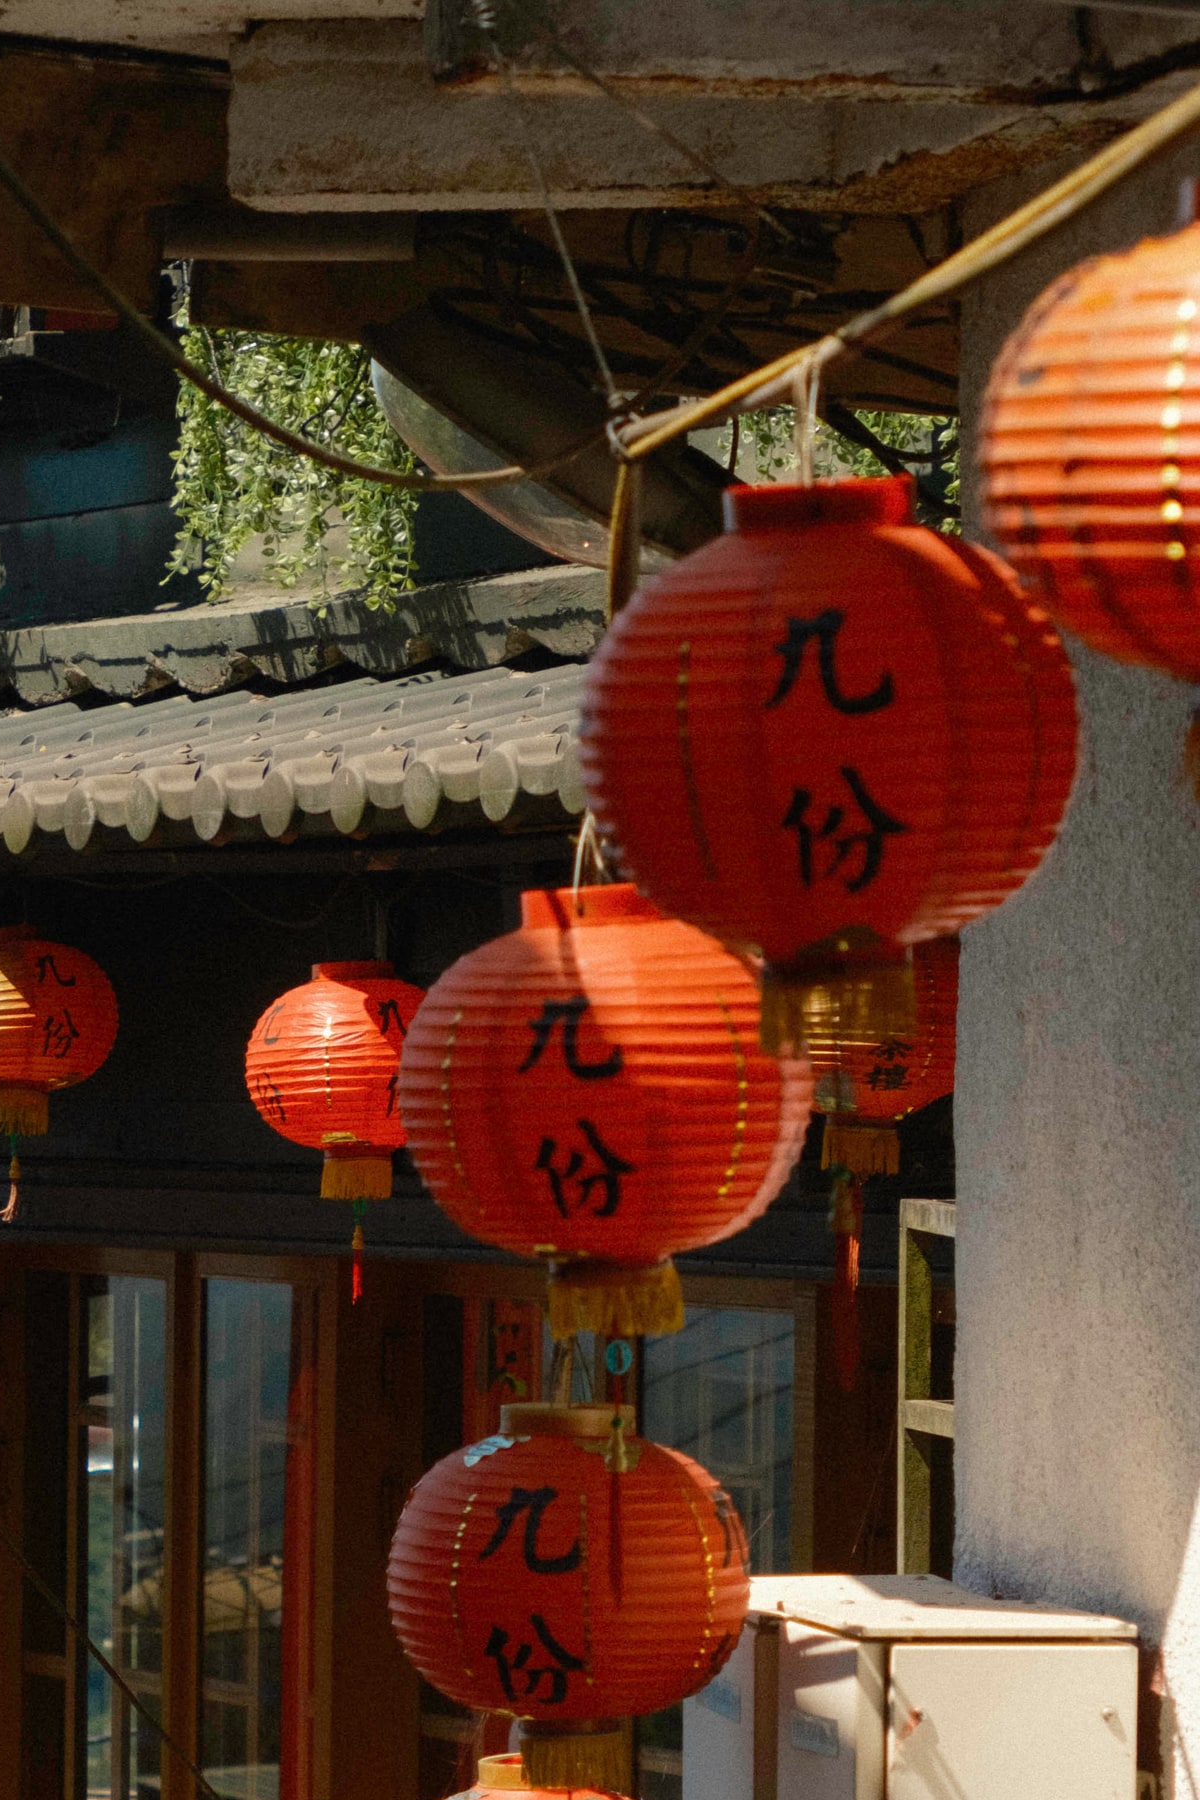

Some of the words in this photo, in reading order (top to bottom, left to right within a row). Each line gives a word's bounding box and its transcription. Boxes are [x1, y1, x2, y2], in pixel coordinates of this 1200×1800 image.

[765, 608, 912, 893] 九份
[36, 954, 80, 1059] 九份
[519, 996, 632, 1219] 九份
[478, 1485, 589, 1705] 九份
